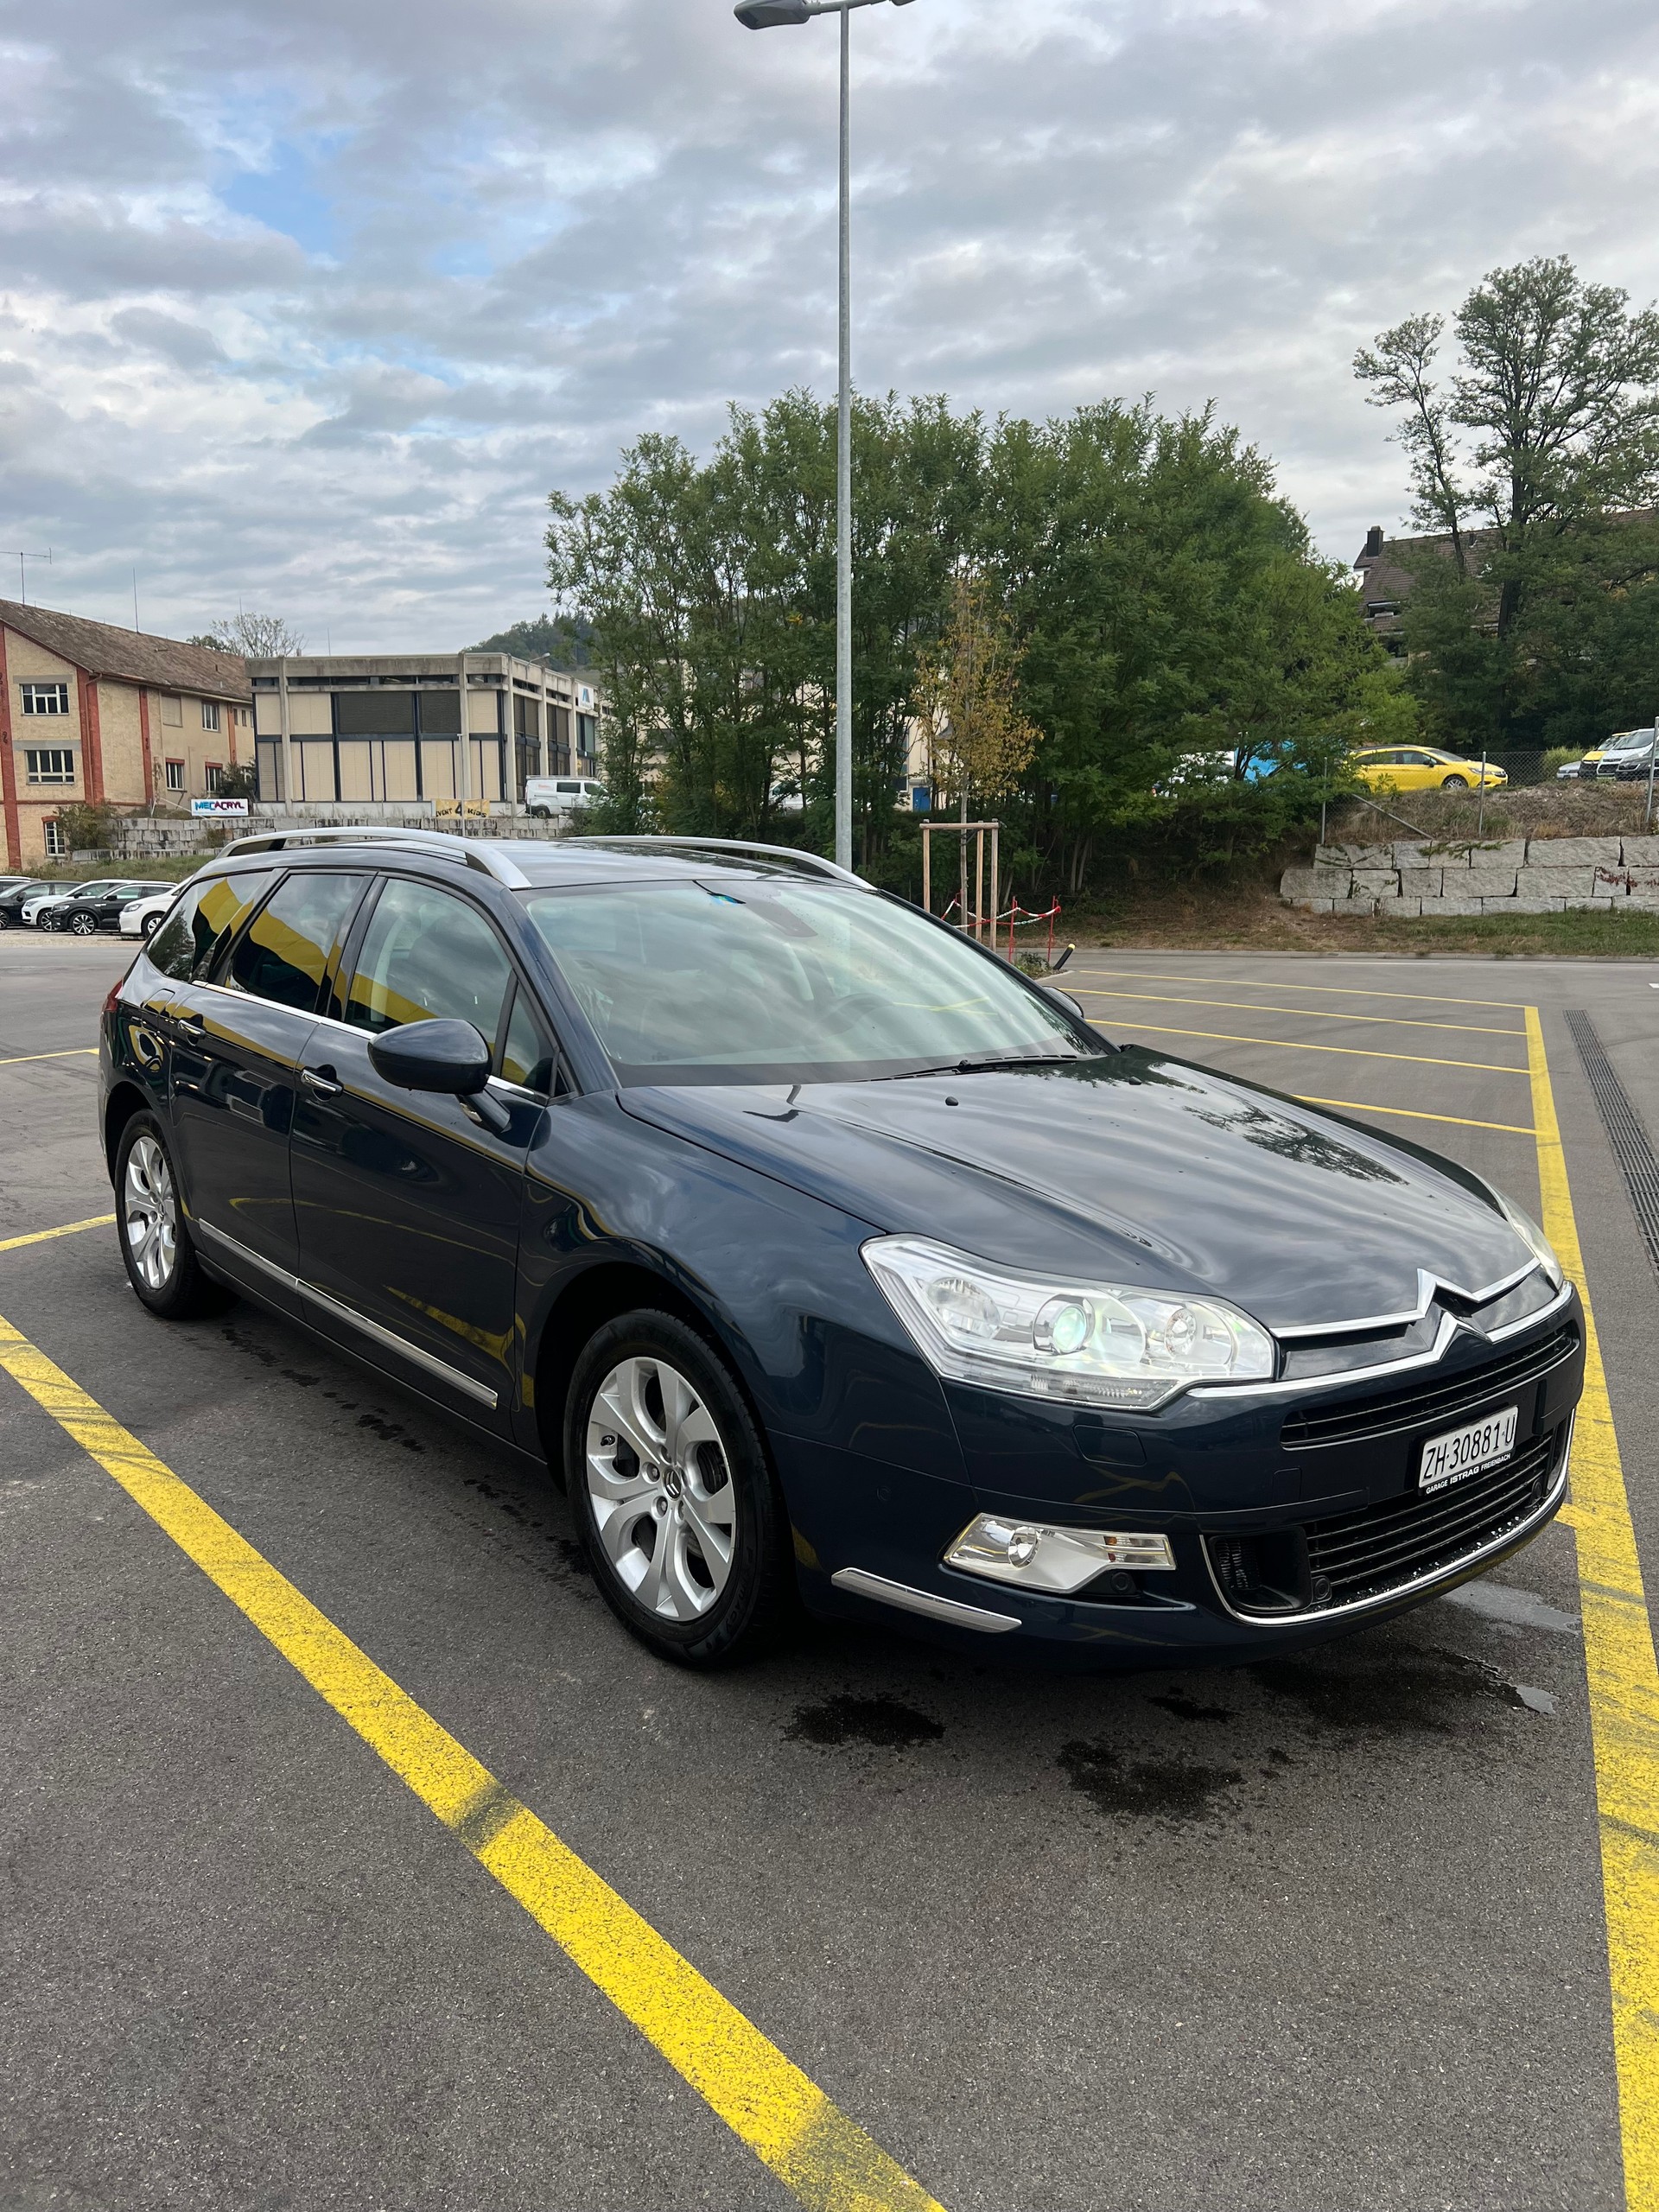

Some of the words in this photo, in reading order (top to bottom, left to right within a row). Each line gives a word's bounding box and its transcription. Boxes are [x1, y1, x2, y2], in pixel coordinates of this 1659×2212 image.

[1426, 1479, 1448, 1494] GARAGE
[1450, 1466, 1479, 1484] ISTRAG
[1481, 1453, 1511, 1471] FREIENBACH
